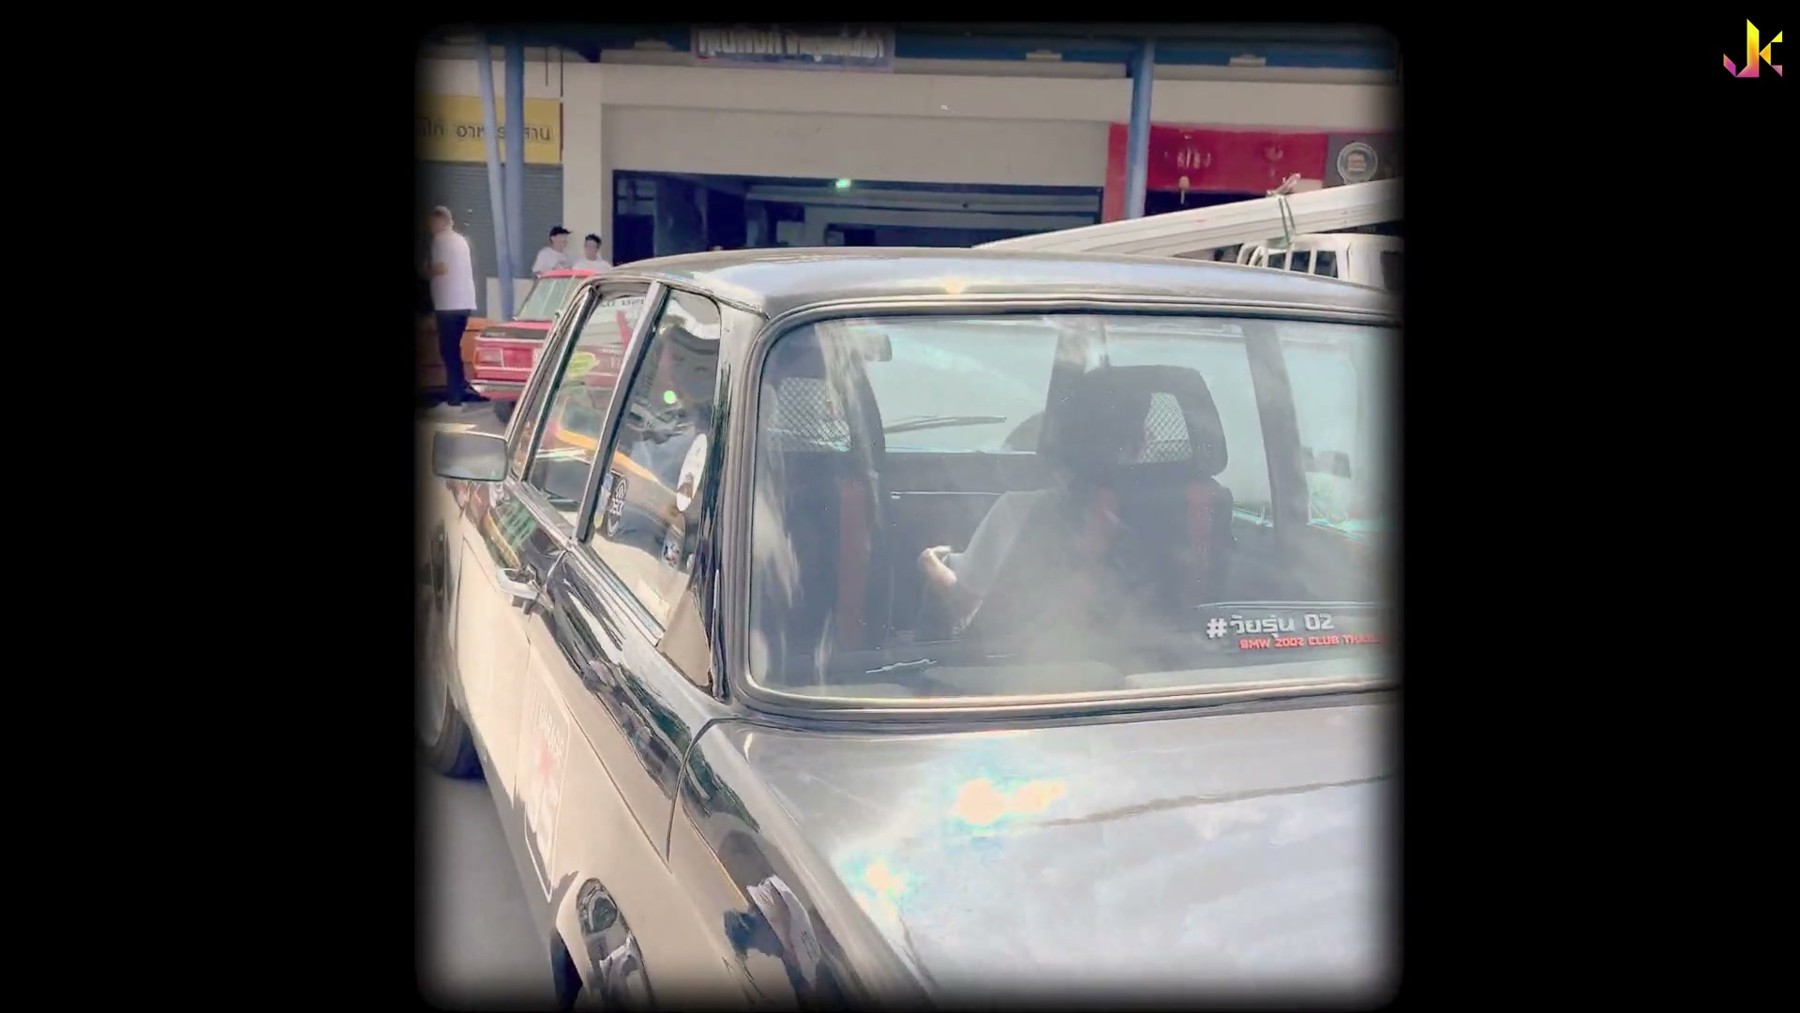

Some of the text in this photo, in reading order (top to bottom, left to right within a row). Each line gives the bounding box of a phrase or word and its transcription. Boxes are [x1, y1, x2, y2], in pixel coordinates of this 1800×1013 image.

[1303, 613, 1335, 631] 02
[1239, 638, 1271, 650] BMW
[1274, 636, 1304, 648] 2002
[1308, 635, 1339, 647] CLUB
